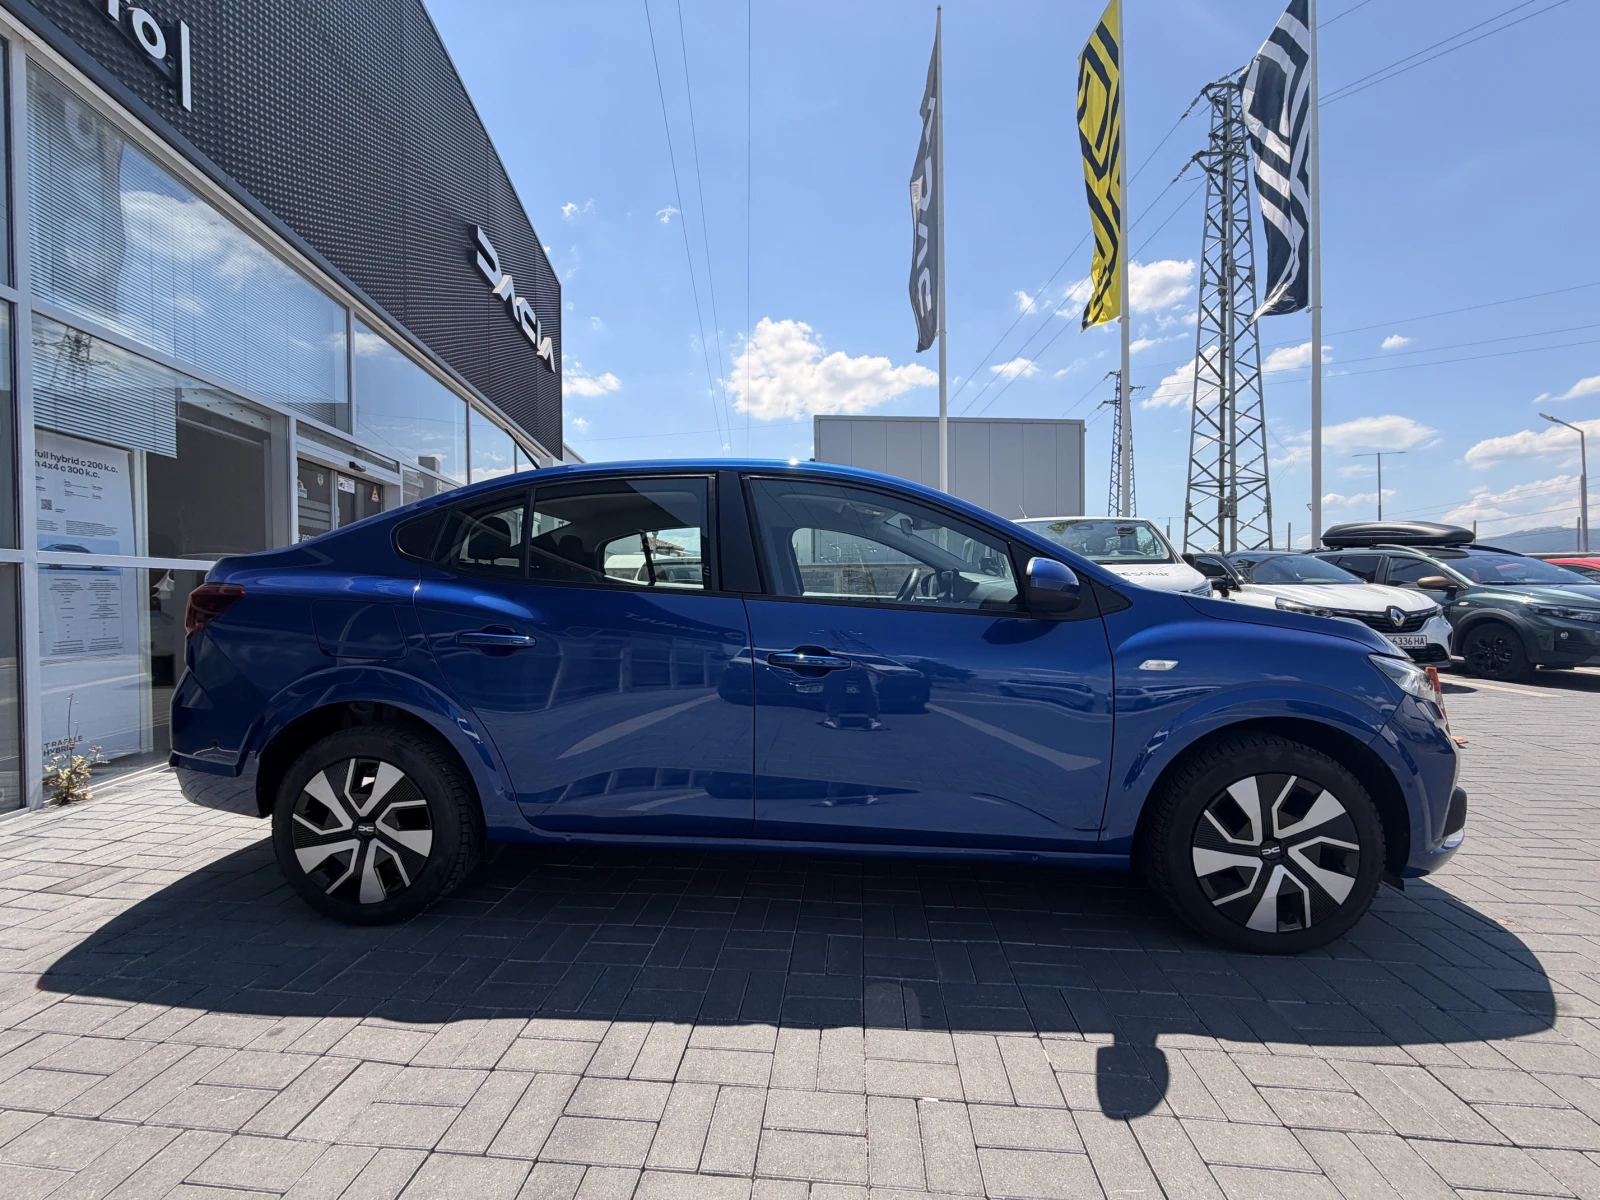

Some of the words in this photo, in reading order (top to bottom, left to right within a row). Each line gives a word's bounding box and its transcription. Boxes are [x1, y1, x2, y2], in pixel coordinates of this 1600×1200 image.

[472, 225, 556, 373] DACIA
[41, 460, 60, 471] 4x4
[67, 465, 84, 476] 300
[50, 451, 80, 466] hybrid
[87, 460, 103, 471] 200
